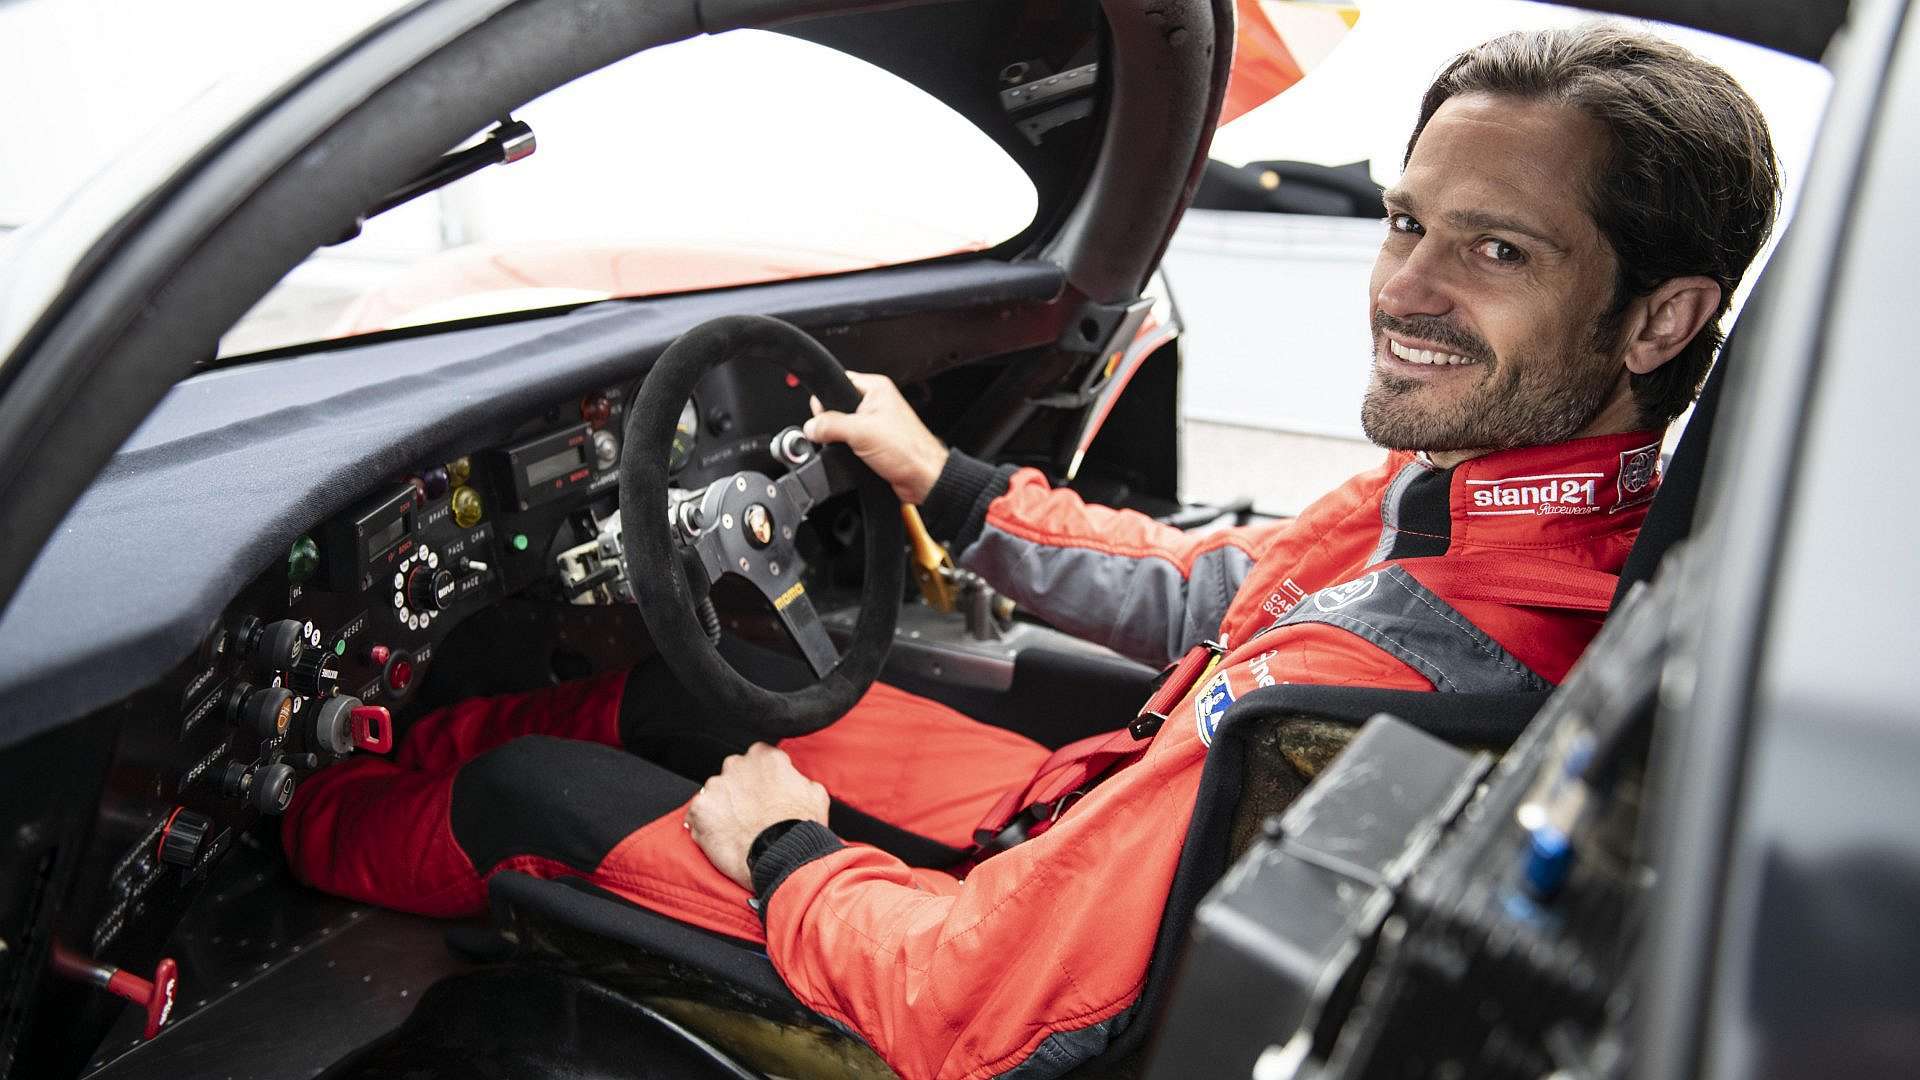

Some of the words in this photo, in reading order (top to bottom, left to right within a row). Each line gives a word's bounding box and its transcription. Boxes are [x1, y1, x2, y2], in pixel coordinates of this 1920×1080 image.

[1473, 479, 1595, 507] stand21
[1536, 502, 1593, 516] Racewear
[343, 619, 363, 638] RESET
[363, 683, 380, 699] FUEL
